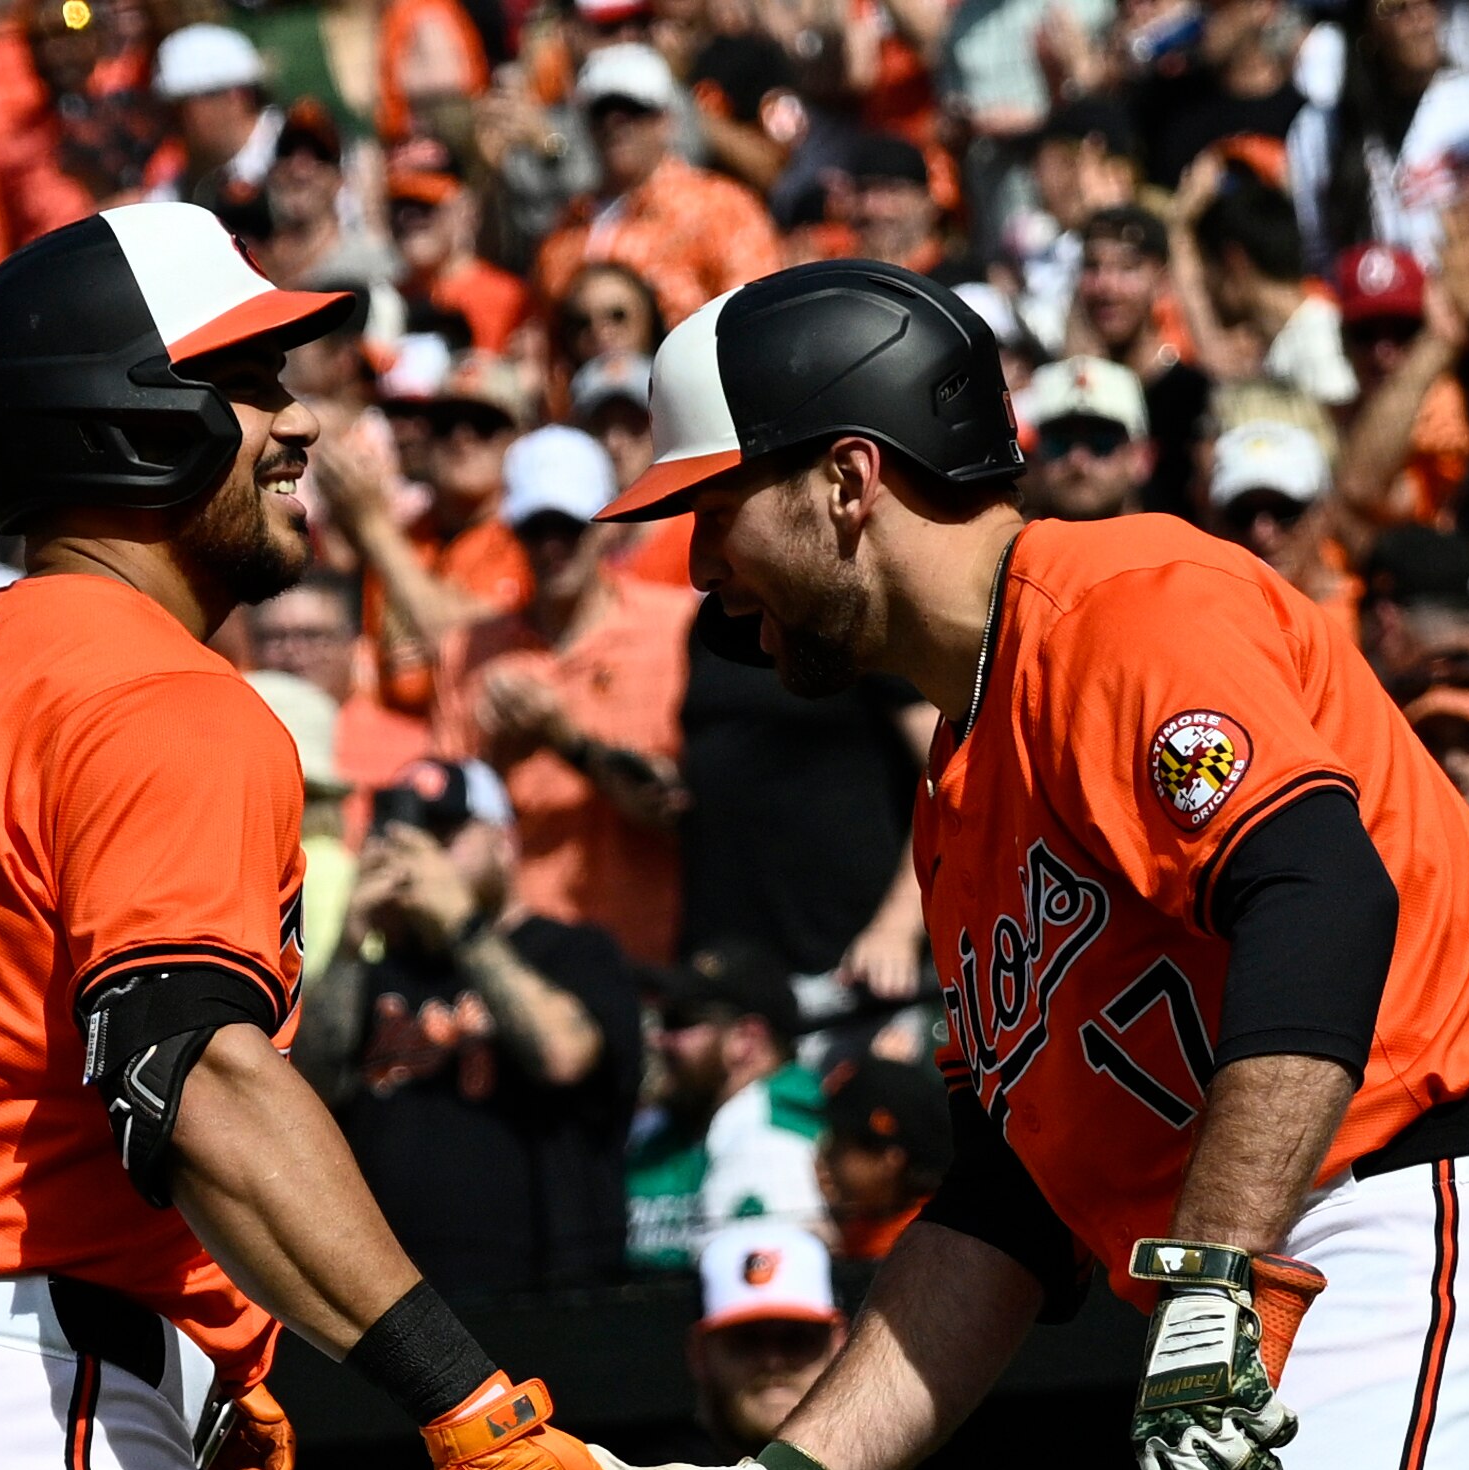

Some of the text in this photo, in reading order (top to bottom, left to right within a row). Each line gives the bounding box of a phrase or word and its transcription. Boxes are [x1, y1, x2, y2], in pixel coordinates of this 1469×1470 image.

[1152, 714, 1221, 798] BALTIMORE
[1191, 759, 1246, 824] ORIOLES
[1079, 953, 1215, 1130] 17
